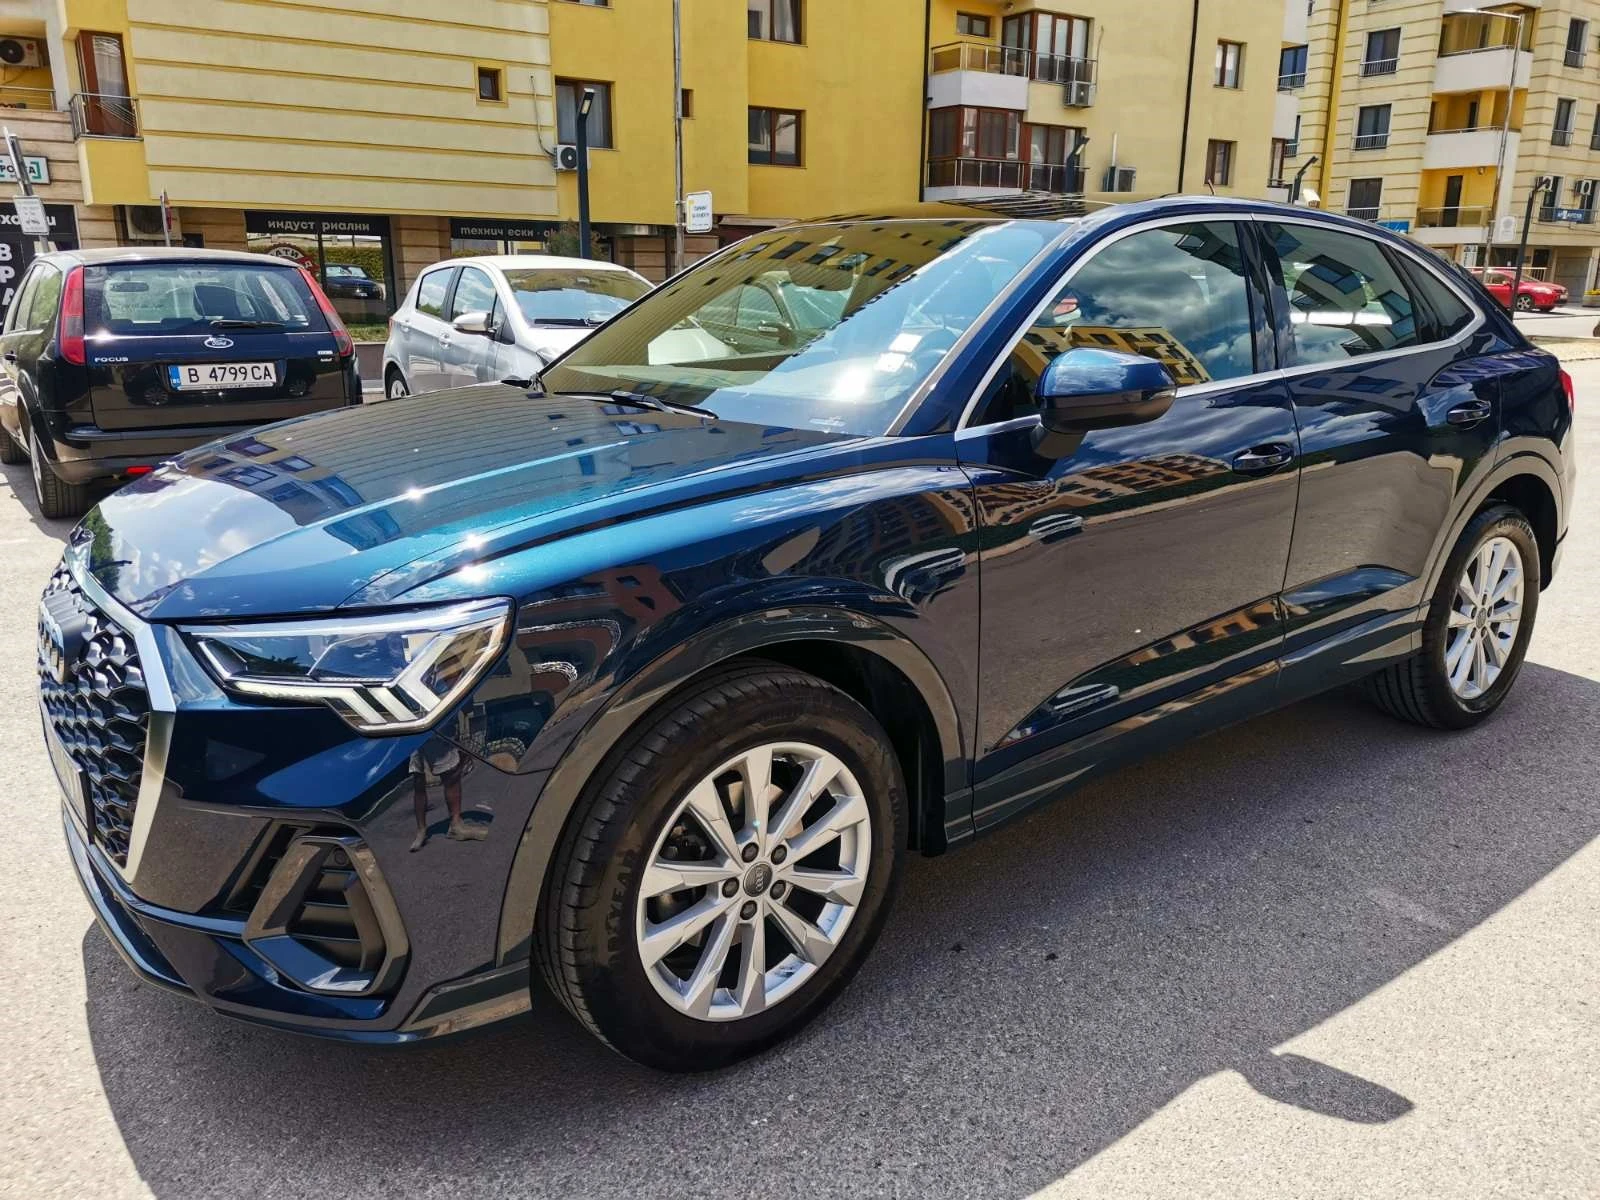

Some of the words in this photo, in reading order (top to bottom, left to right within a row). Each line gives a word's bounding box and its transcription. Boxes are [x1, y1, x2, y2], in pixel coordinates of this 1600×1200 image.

[267, 219, 315, 231] индуст
[322, 221, 370, 232] риални
[460, 226, 504, 236] технич
[507, 228, 534, 237] ески
[94, 355, 129, 363] FOCUS
[187, 367, 200, 383] B
[209, 366, 248, 382] 4799
[251, 365, 273, 381] CA
